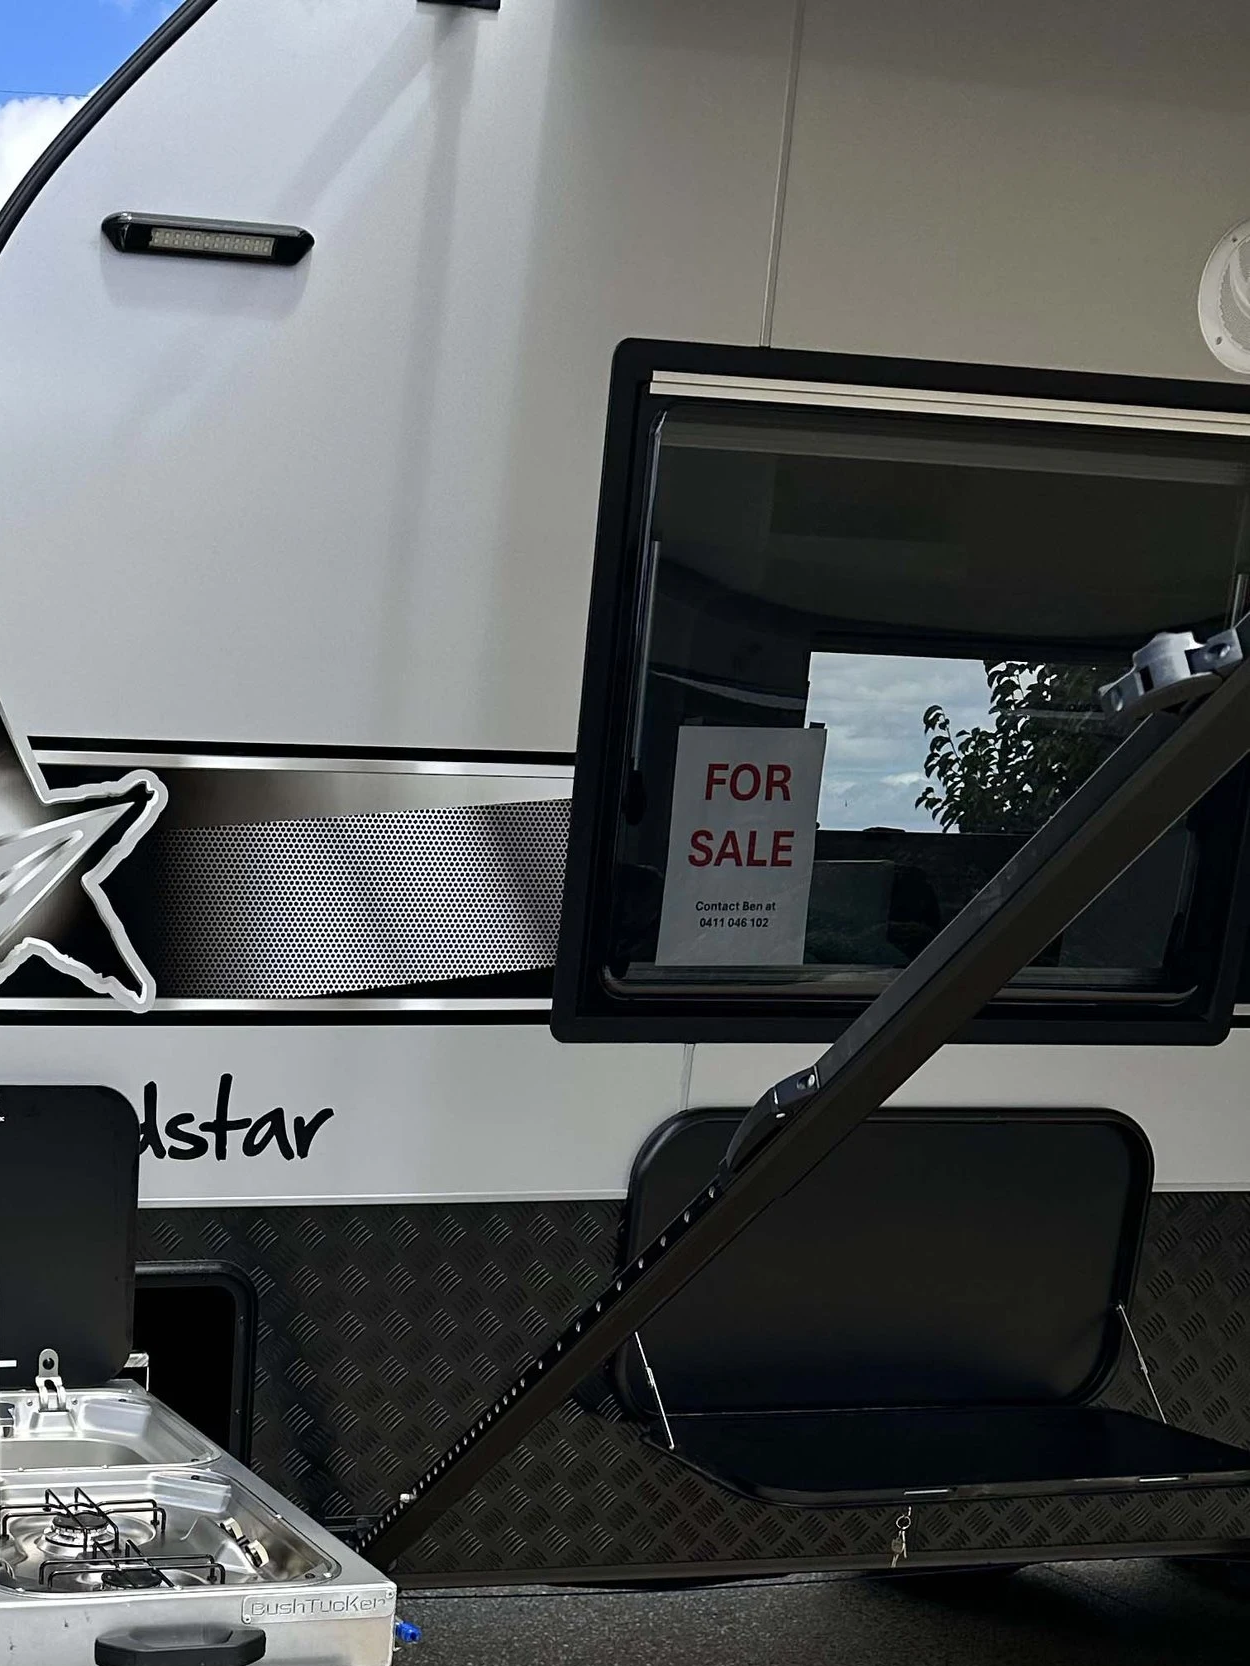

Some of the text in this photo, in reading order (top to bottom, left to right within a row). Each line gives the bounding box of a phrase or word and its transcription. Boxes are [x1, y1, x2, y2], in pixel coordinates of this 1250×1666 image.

[704, 763, 792, 802] FOR
[688, 829, 795, 868] SALE
[695, 901, 776, 912] Contact Ben at
[699, 918, 769, 928] 0411 046 102
